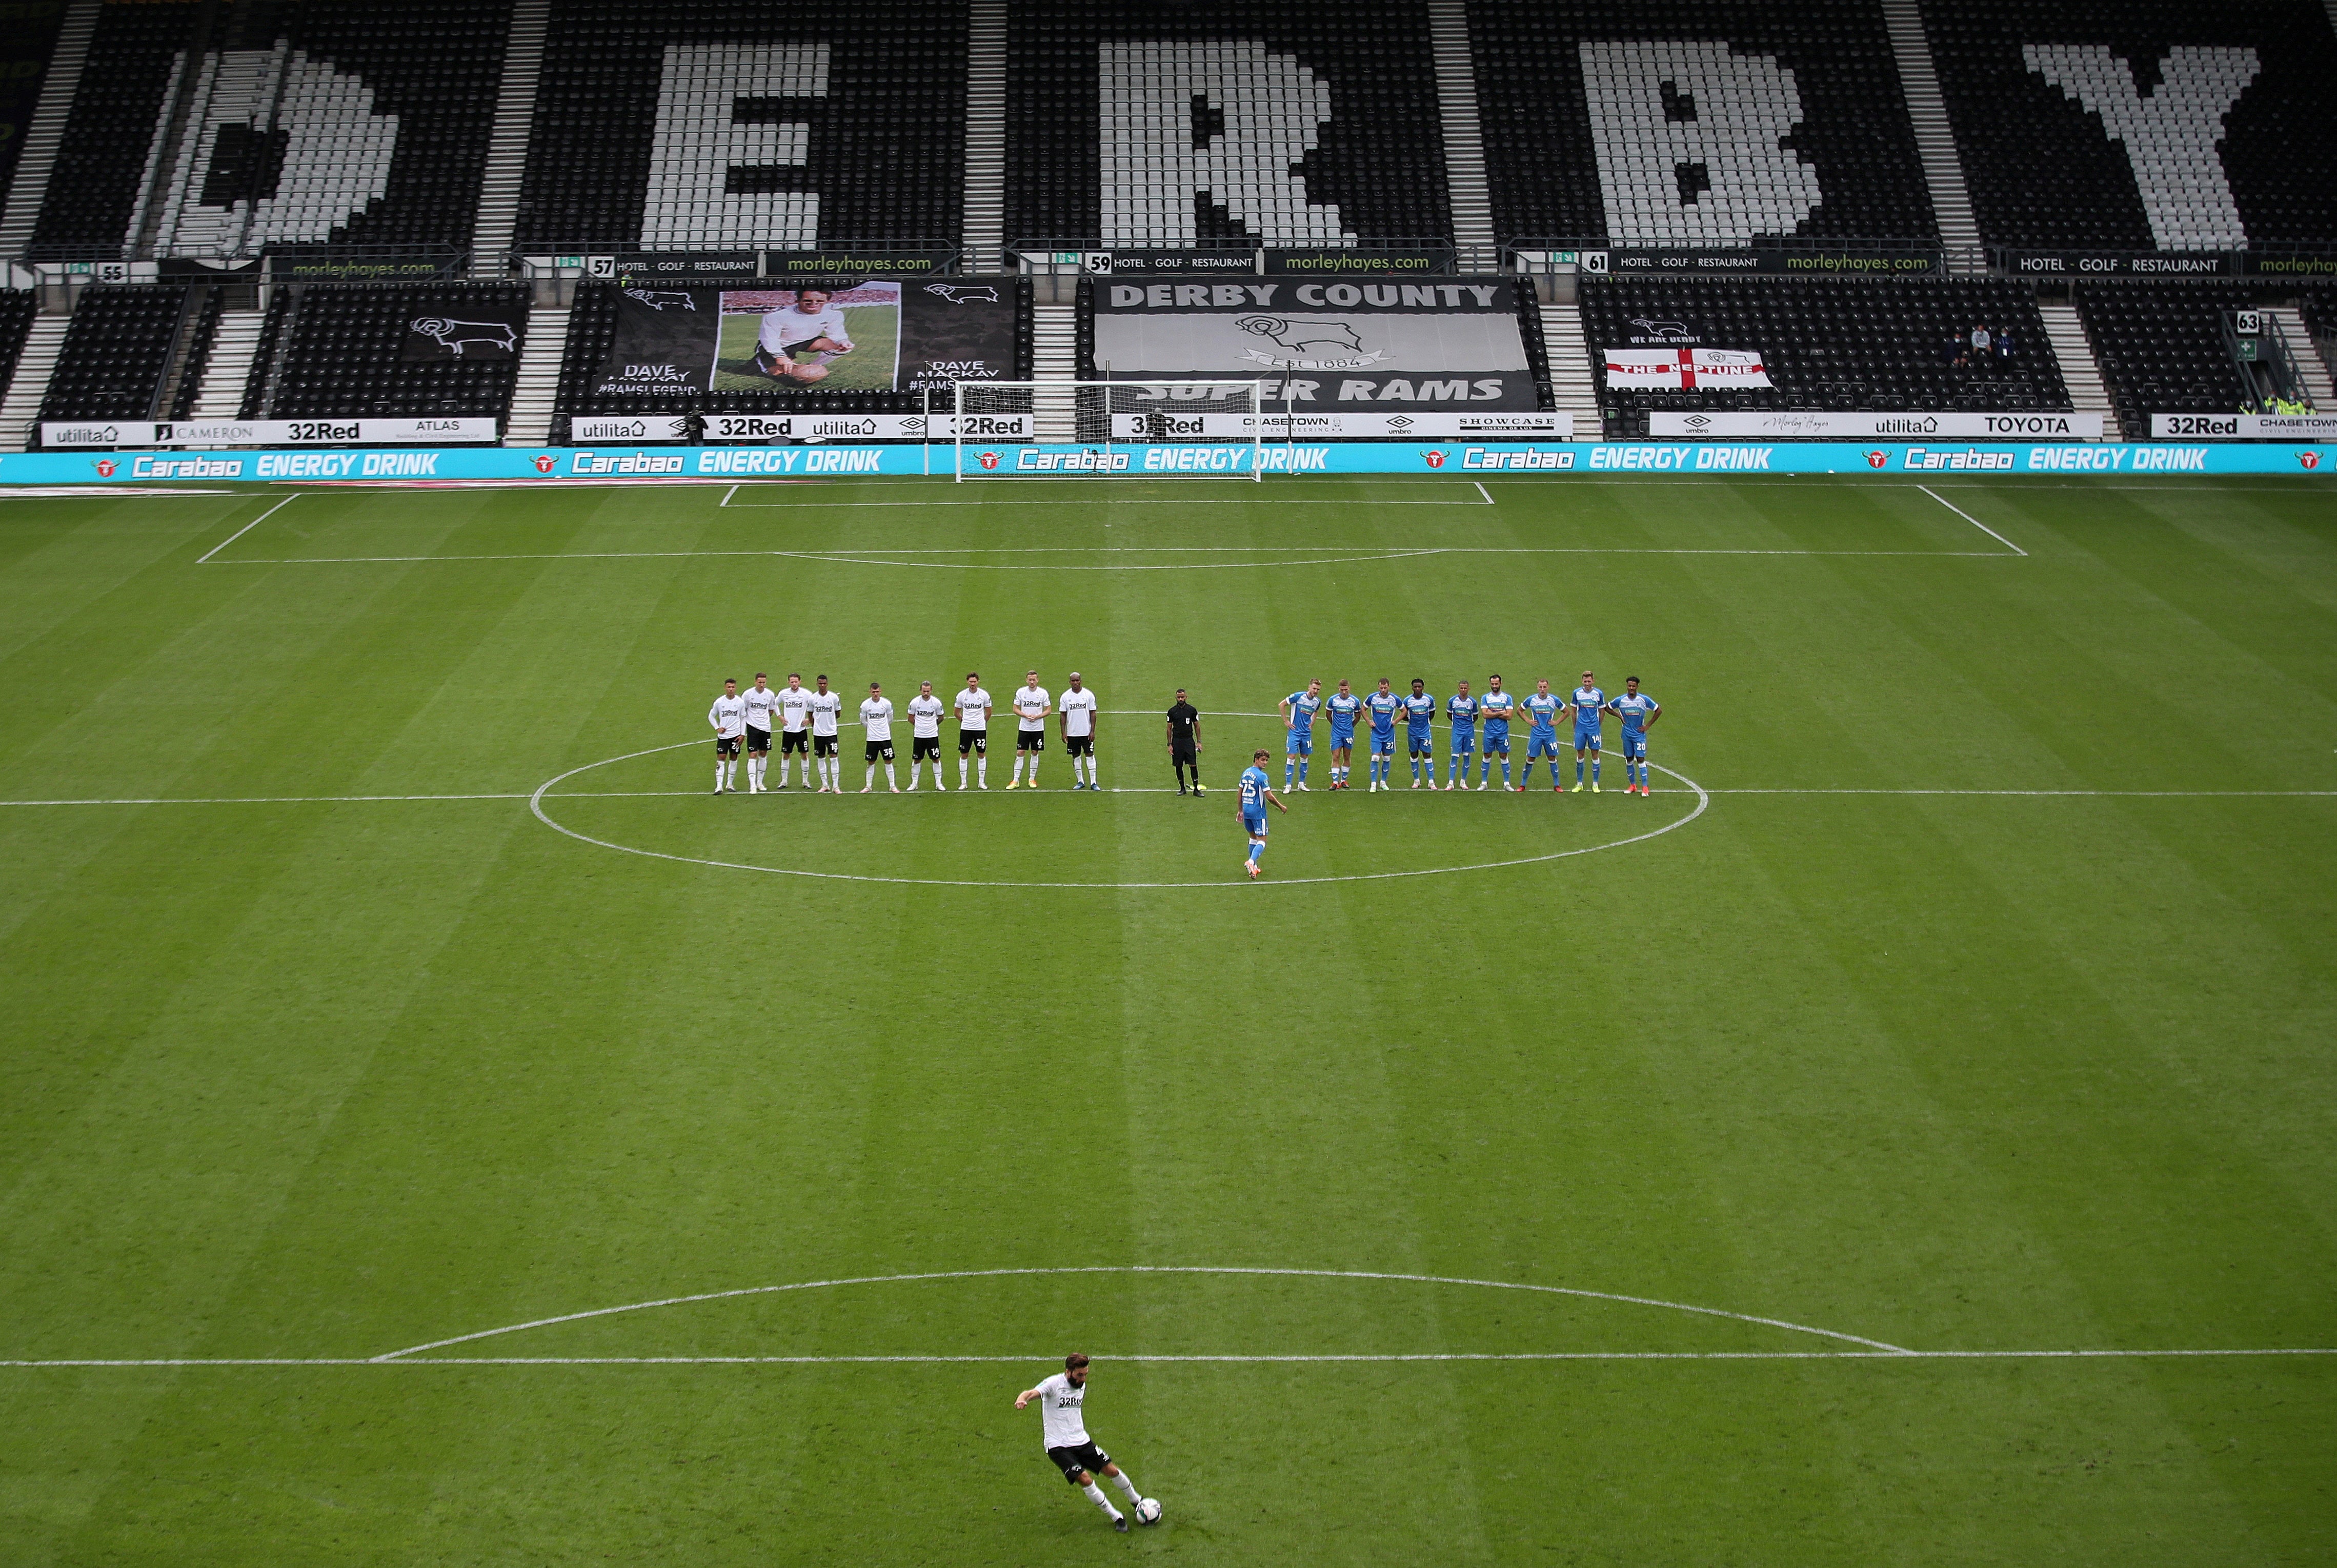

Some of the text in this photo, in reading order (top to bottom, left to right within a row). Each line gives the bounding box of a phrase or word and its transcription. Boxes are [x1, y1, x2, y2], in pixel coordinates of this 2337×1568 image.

[293, 260, 435, 280] morleyhayes.com
[594, 259, 612, 275] 57
[617, 261, 647, 272] HOTEL
[657, 261, 684, 271] GOLF
[694, 260, 755, 271] RESTAURANT
[788, 256, 932, 274] morleyhayes.com
[1091, 256, 1111, 271] 59
[1114, 258, 1145, 268] HOTEL
[1155, 258, 1182, 268] GOLF
[1192, 258, 1253, 268] RESTAURANT
[1285, 254, 1429, 273] morleyhayes.com
[1589, 256, 1606, 270] 61
[1621, 257, 1653, 268] HOTEL
[1661, 257, 1689, 268] GOLF
[1698, 257, 1758, 268] RESTAURANT
[1787, 254, 1928, 273] morleyhayes.com
[2020, 258, 2065, 272] HOTEL
[2079, 258, 2119, 272] GOLF
[2132, 259, 2219, 272] RESTAURANT
[103, 266, 123, 280] 55
[1110, 284, 1499, 307] DERBY COUNTY
[2239, 313, 2257, 329] 63
[624, 365, 676, 377] DAVE
[932, 360, 985, 371] DAVE
[1316, 358, 1361, 368] 1884
[1621, 363, 1754, 375] THE NEPTUNE
[917, 369, 999, 378] MACKAY
[1135, 379, 1503, 401] SUPER RAMS
[288, 422, 360, 440] 32Red
[415, 421, 460, 431] ATLAS
[583, 423, 630, 437] utilita
[719, 418, 792, 435] 32Red
[813, 418, 860, 435] utilita
[1131, 416, 1204, 434] 3Red
[1875, 418, 1922, 433] utilita
[1984, 417, 2070, 433] TOYOTA
[2167, 417, 2238, 434] 32Red
[56, 429, 103, 443] utilita
[176, 426, 254, 441] CAMERON
[131, 453, 439, 478] Carabao ENERGY DRINK
[571, 450, 884, 473] Carabao ENERGY DRINK
[1016, 447, 1331, 470] Carabao ENERGY DRINK
[1462, 447, 1774, 470] Carabao ENERGY DRINK
[1903, 447, 2209, 470] Carabao ENERGY DRINK
[1636, 743, 1646, 751] 20
